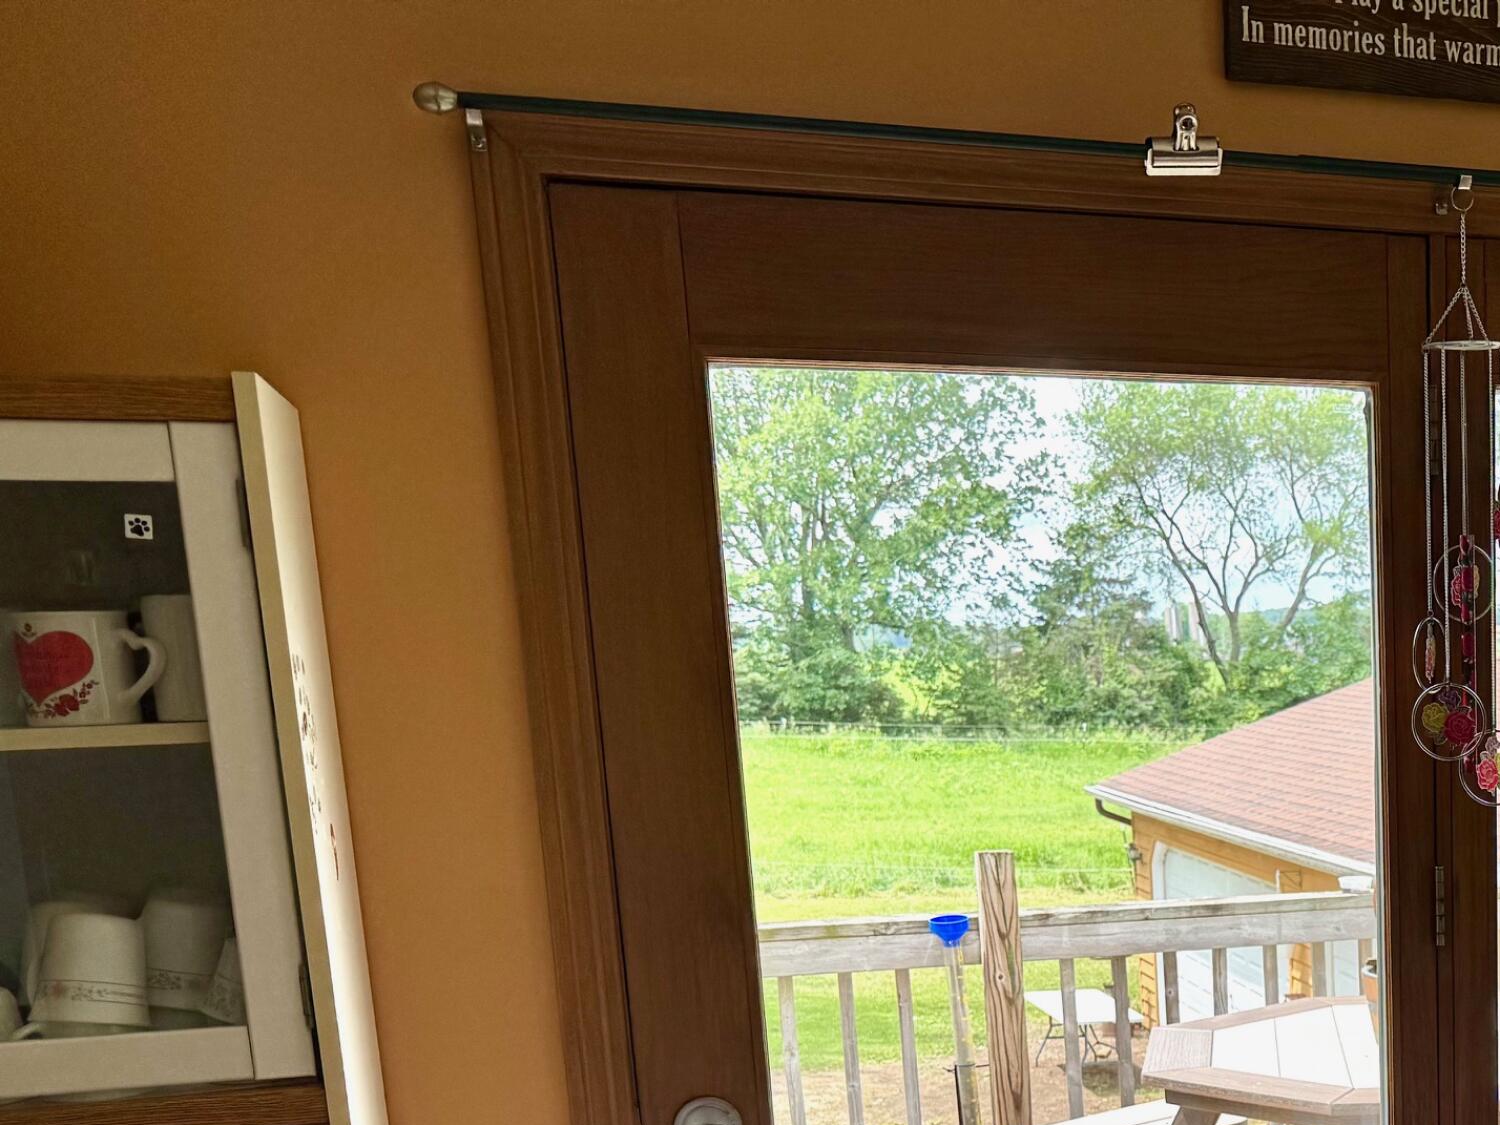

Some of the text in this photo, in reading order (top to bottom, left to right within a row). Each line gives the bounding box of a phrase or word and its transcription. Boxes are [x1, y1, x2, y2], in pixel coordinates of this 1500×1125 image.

[1412, 0, 1489, 20] special
[1241, 5, 1265, 43] In
[1273, 20, 1386, 56] memories
[1393, 22, 1437, 60] that
